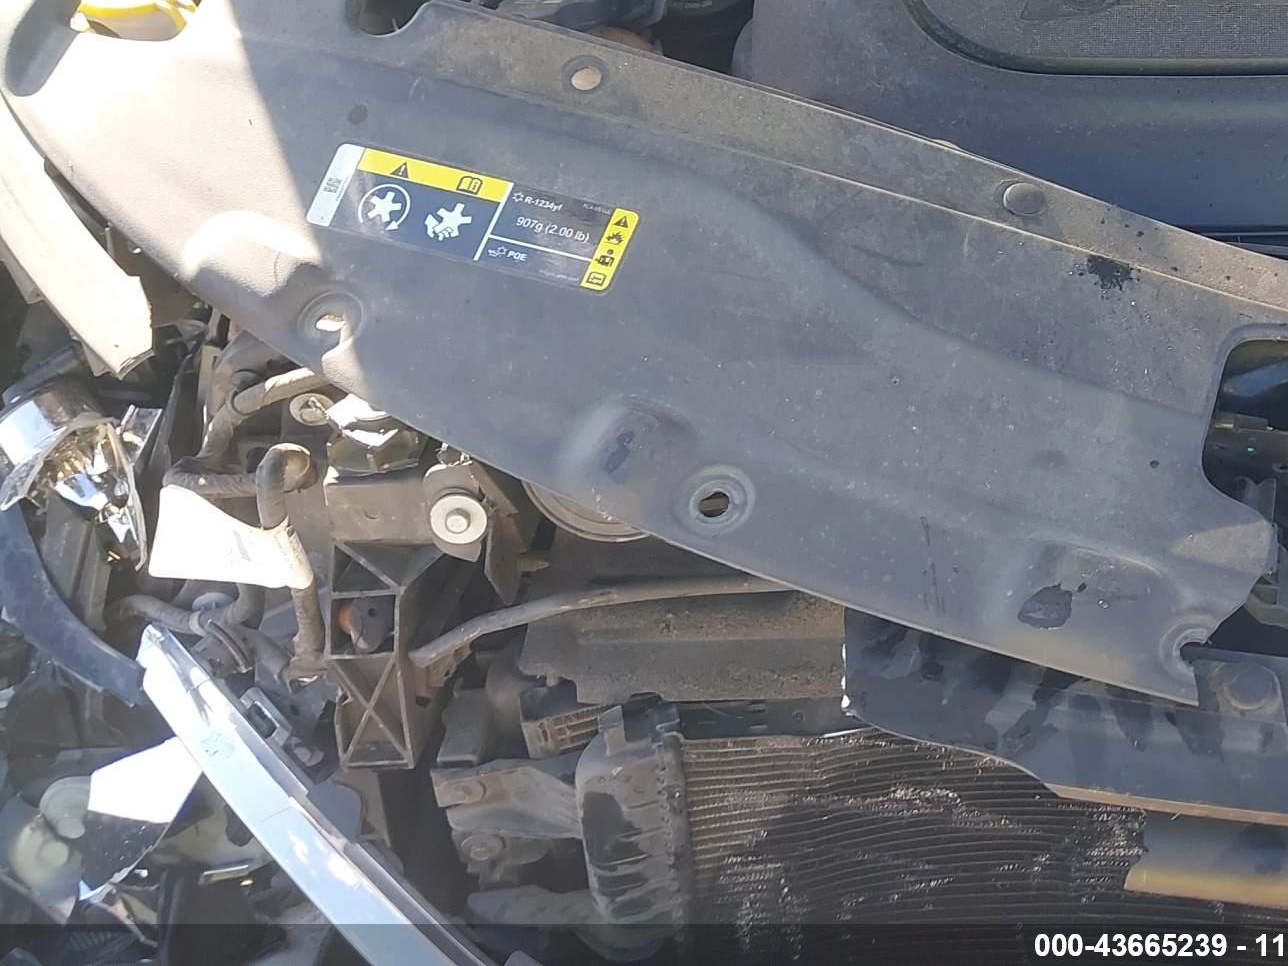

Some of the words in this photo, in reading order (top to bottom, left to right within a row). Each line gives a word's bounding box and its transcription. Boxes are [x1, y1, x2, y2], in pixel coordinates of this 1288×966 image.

[523, 195, 563, 212] R-1234yf
[516, 216, 543, 234] 907g
[545, 222, 574, 238] (2.00
[574, 229, 590, 244] lb)
[508, 250, 527, 262] POE
